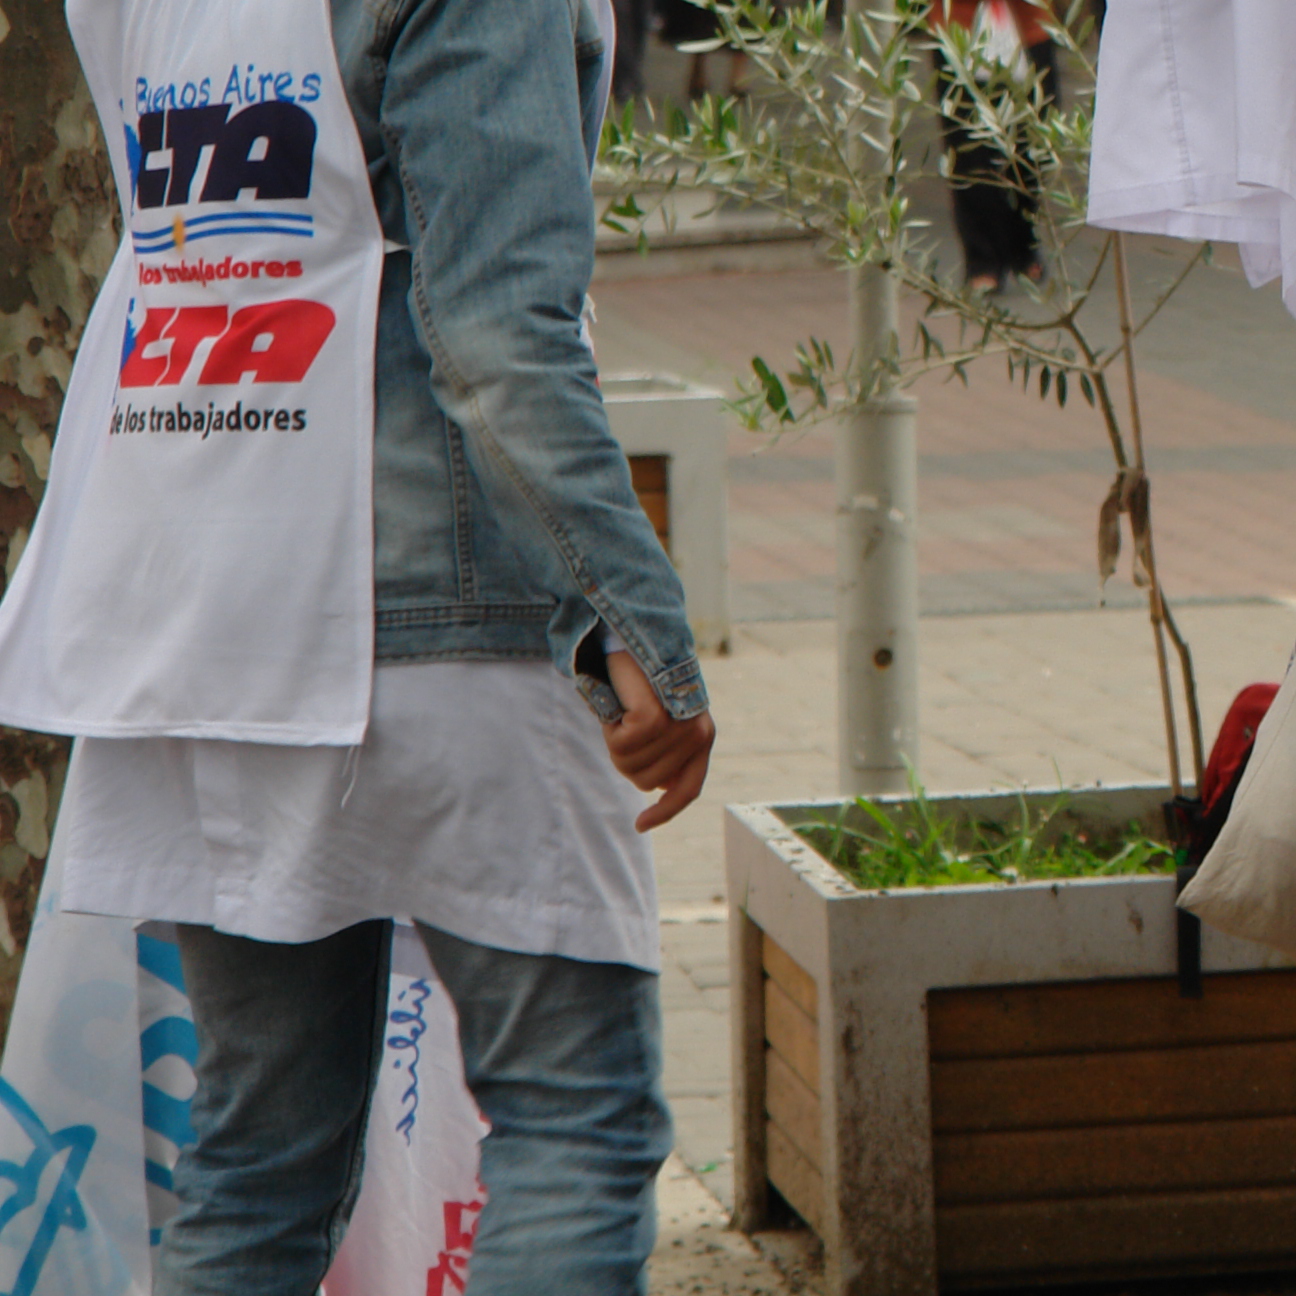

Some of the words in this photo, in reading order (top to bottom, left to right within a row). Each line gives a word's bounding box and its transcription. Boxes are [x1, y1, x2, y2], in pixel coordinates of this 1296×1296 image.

[222, 64, 321, 104] Aires
[123, 403, 146, 434] los
[149, 400, 307, 441] trabajadores
